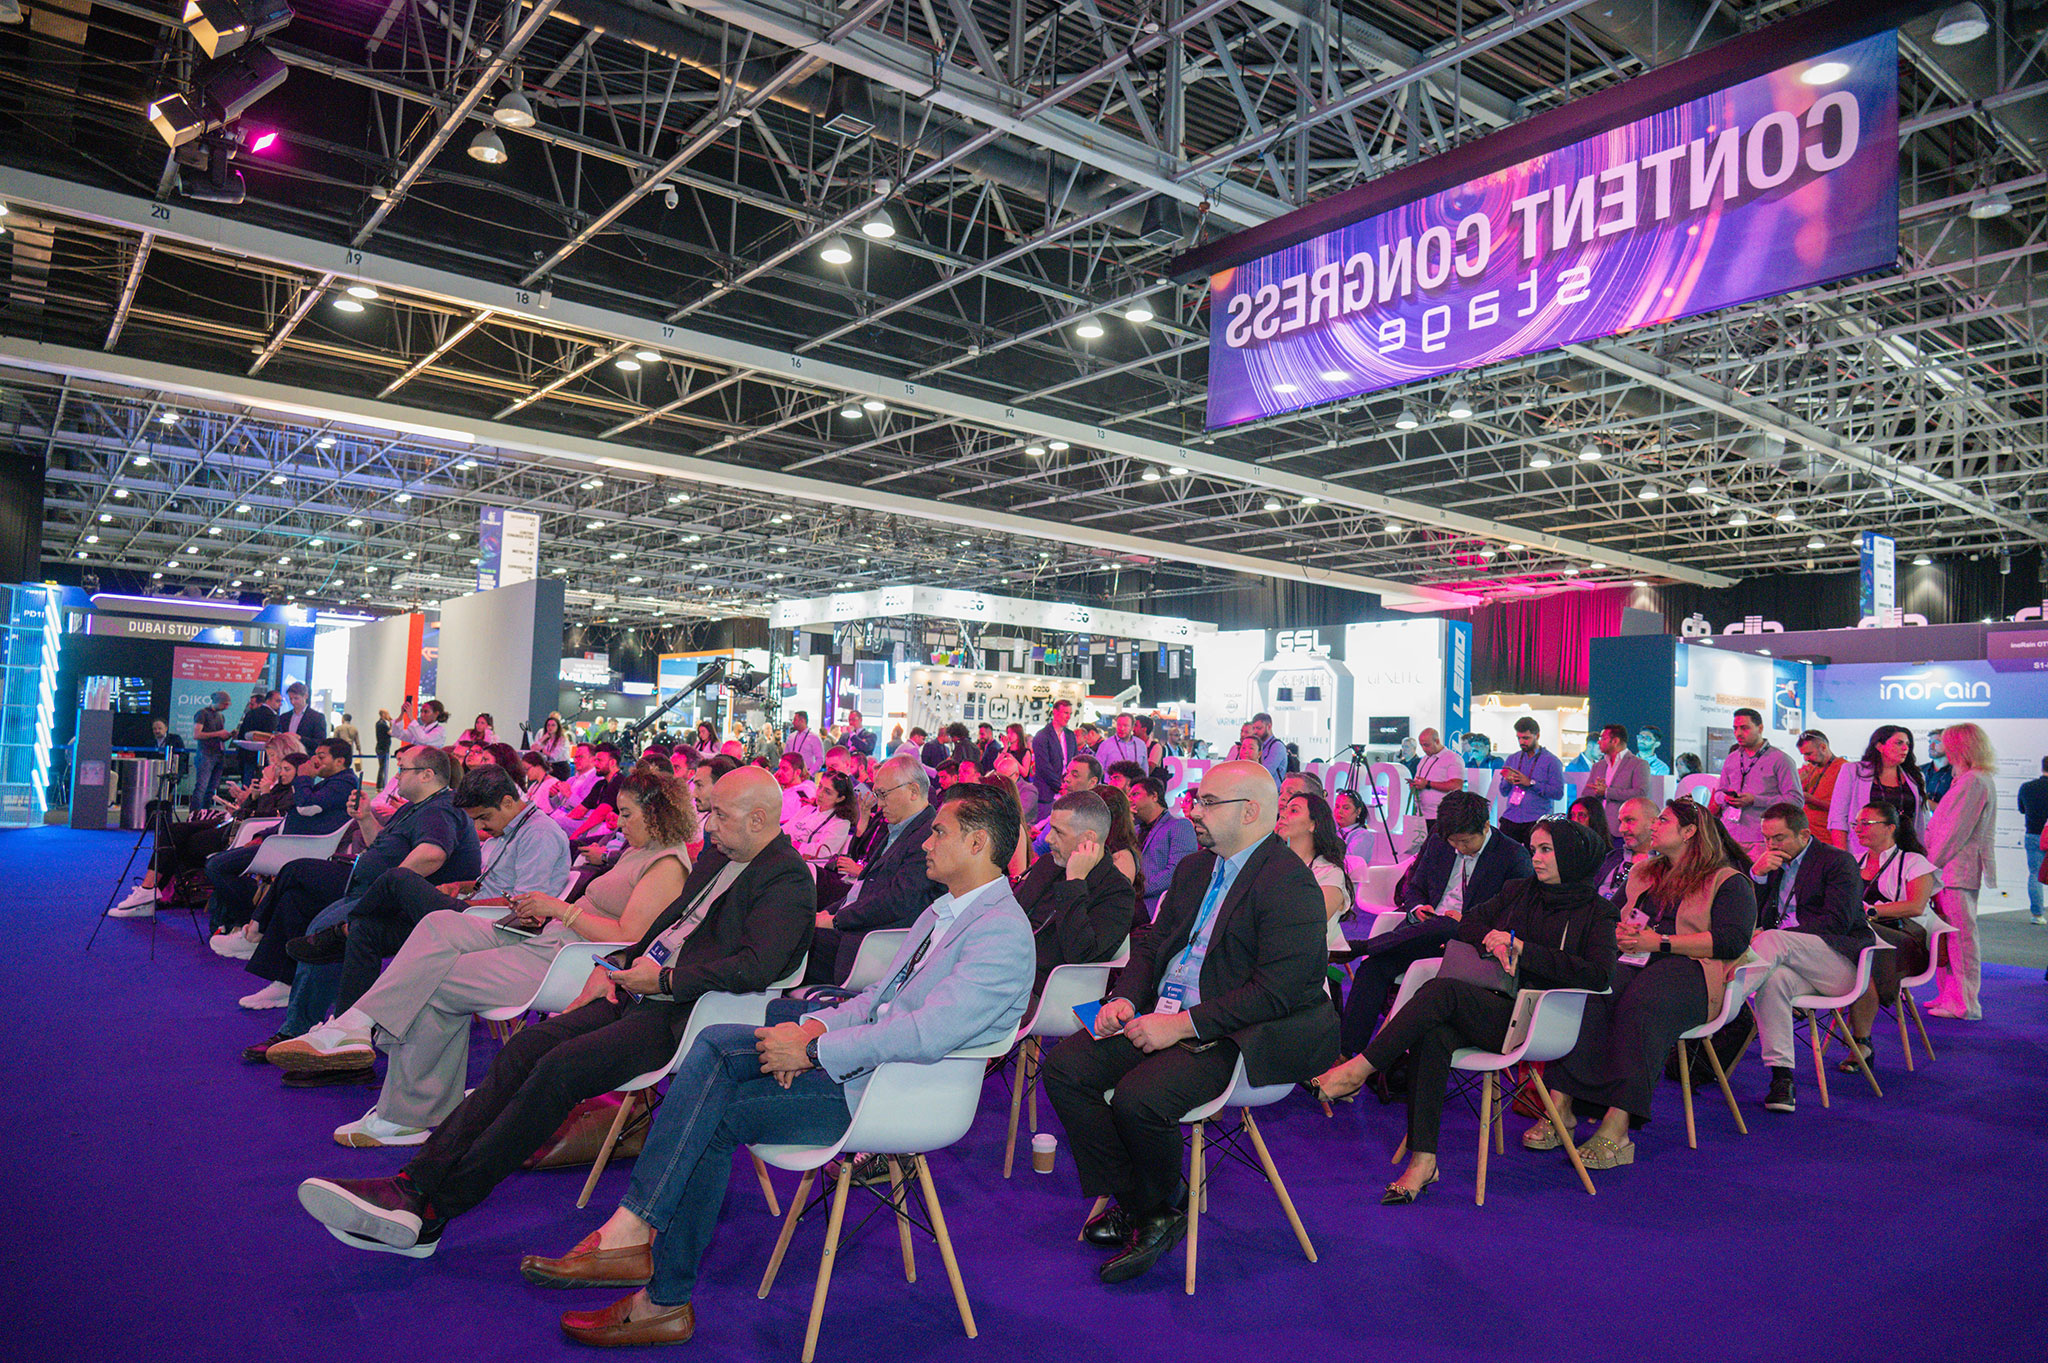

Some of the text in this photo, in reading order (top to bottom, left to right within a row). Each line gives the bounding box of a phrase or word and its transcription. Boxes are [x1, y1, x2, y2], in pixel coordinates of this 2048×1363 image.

[152, 204, 169, 220] 20
[346, 251, 362, 265] 19
[515, 291, 530, 305] 18
[662, 326, 675, 338] 17
[791, 357, 802, 369] 16
[904, 384, 915, 395] 15
[1179, 448, 1187, 458] 12
[1253, 466, 1261, 475] 11
[128, 621, 165, 634] DUBAI
[1276, 629, 1331, 653] GSL
